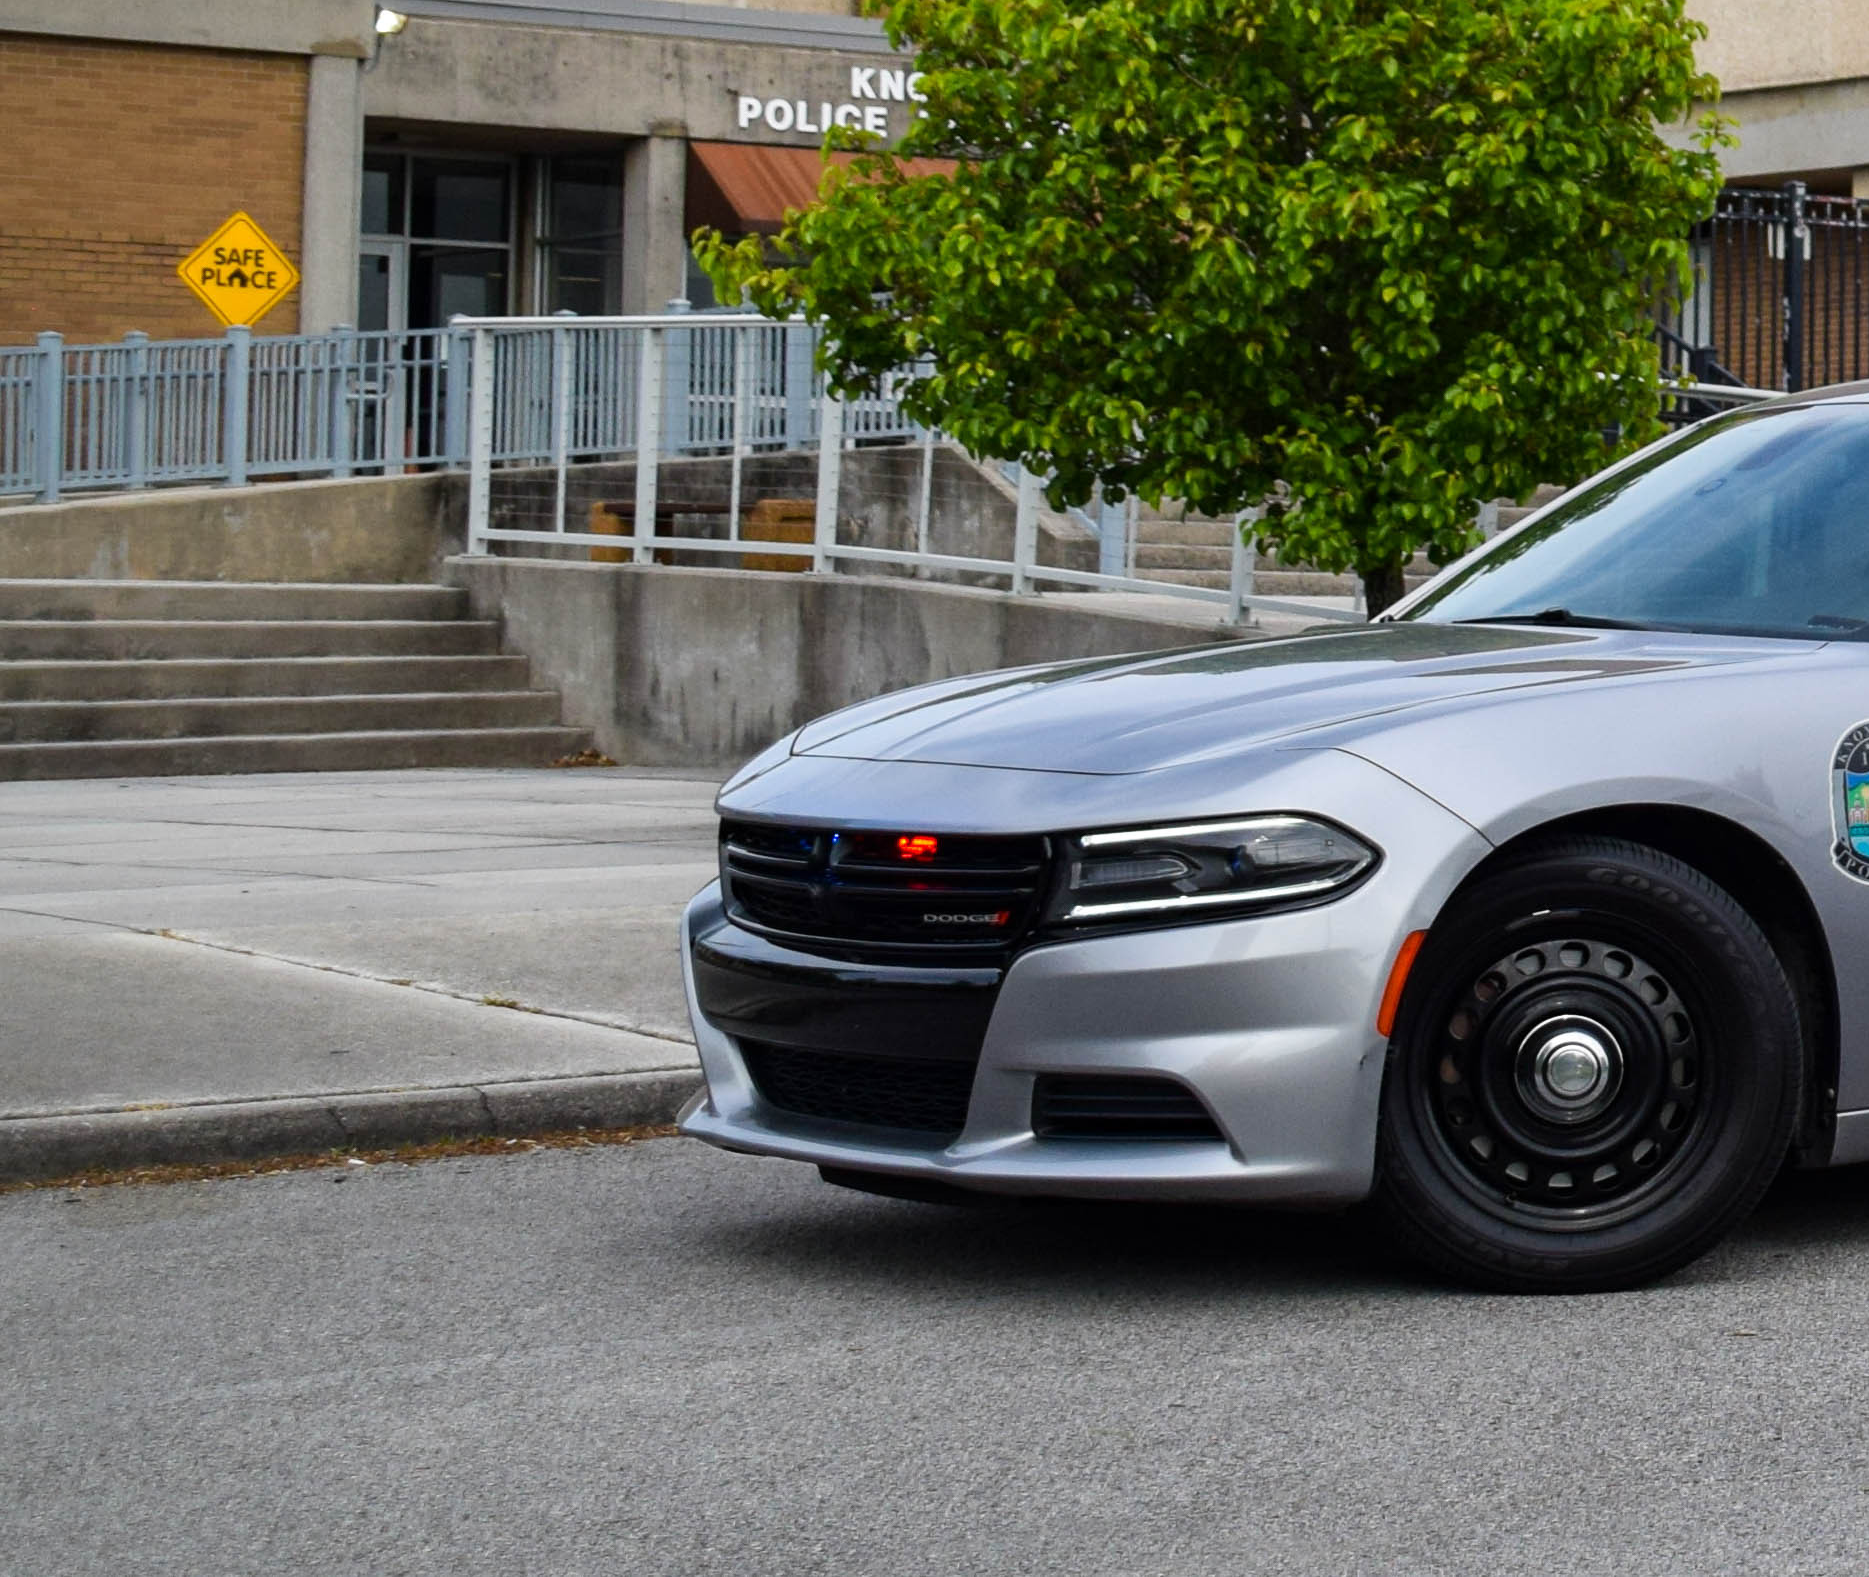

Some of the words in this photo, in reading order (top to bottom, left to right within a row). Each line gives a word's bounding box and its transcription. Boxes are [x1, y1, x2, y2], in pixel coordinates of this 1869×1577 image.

[738, 96, 888, 138] POLICE
[214, 247, 265, 268] SAFE
[923, 913, 1000, 923] DODGE
